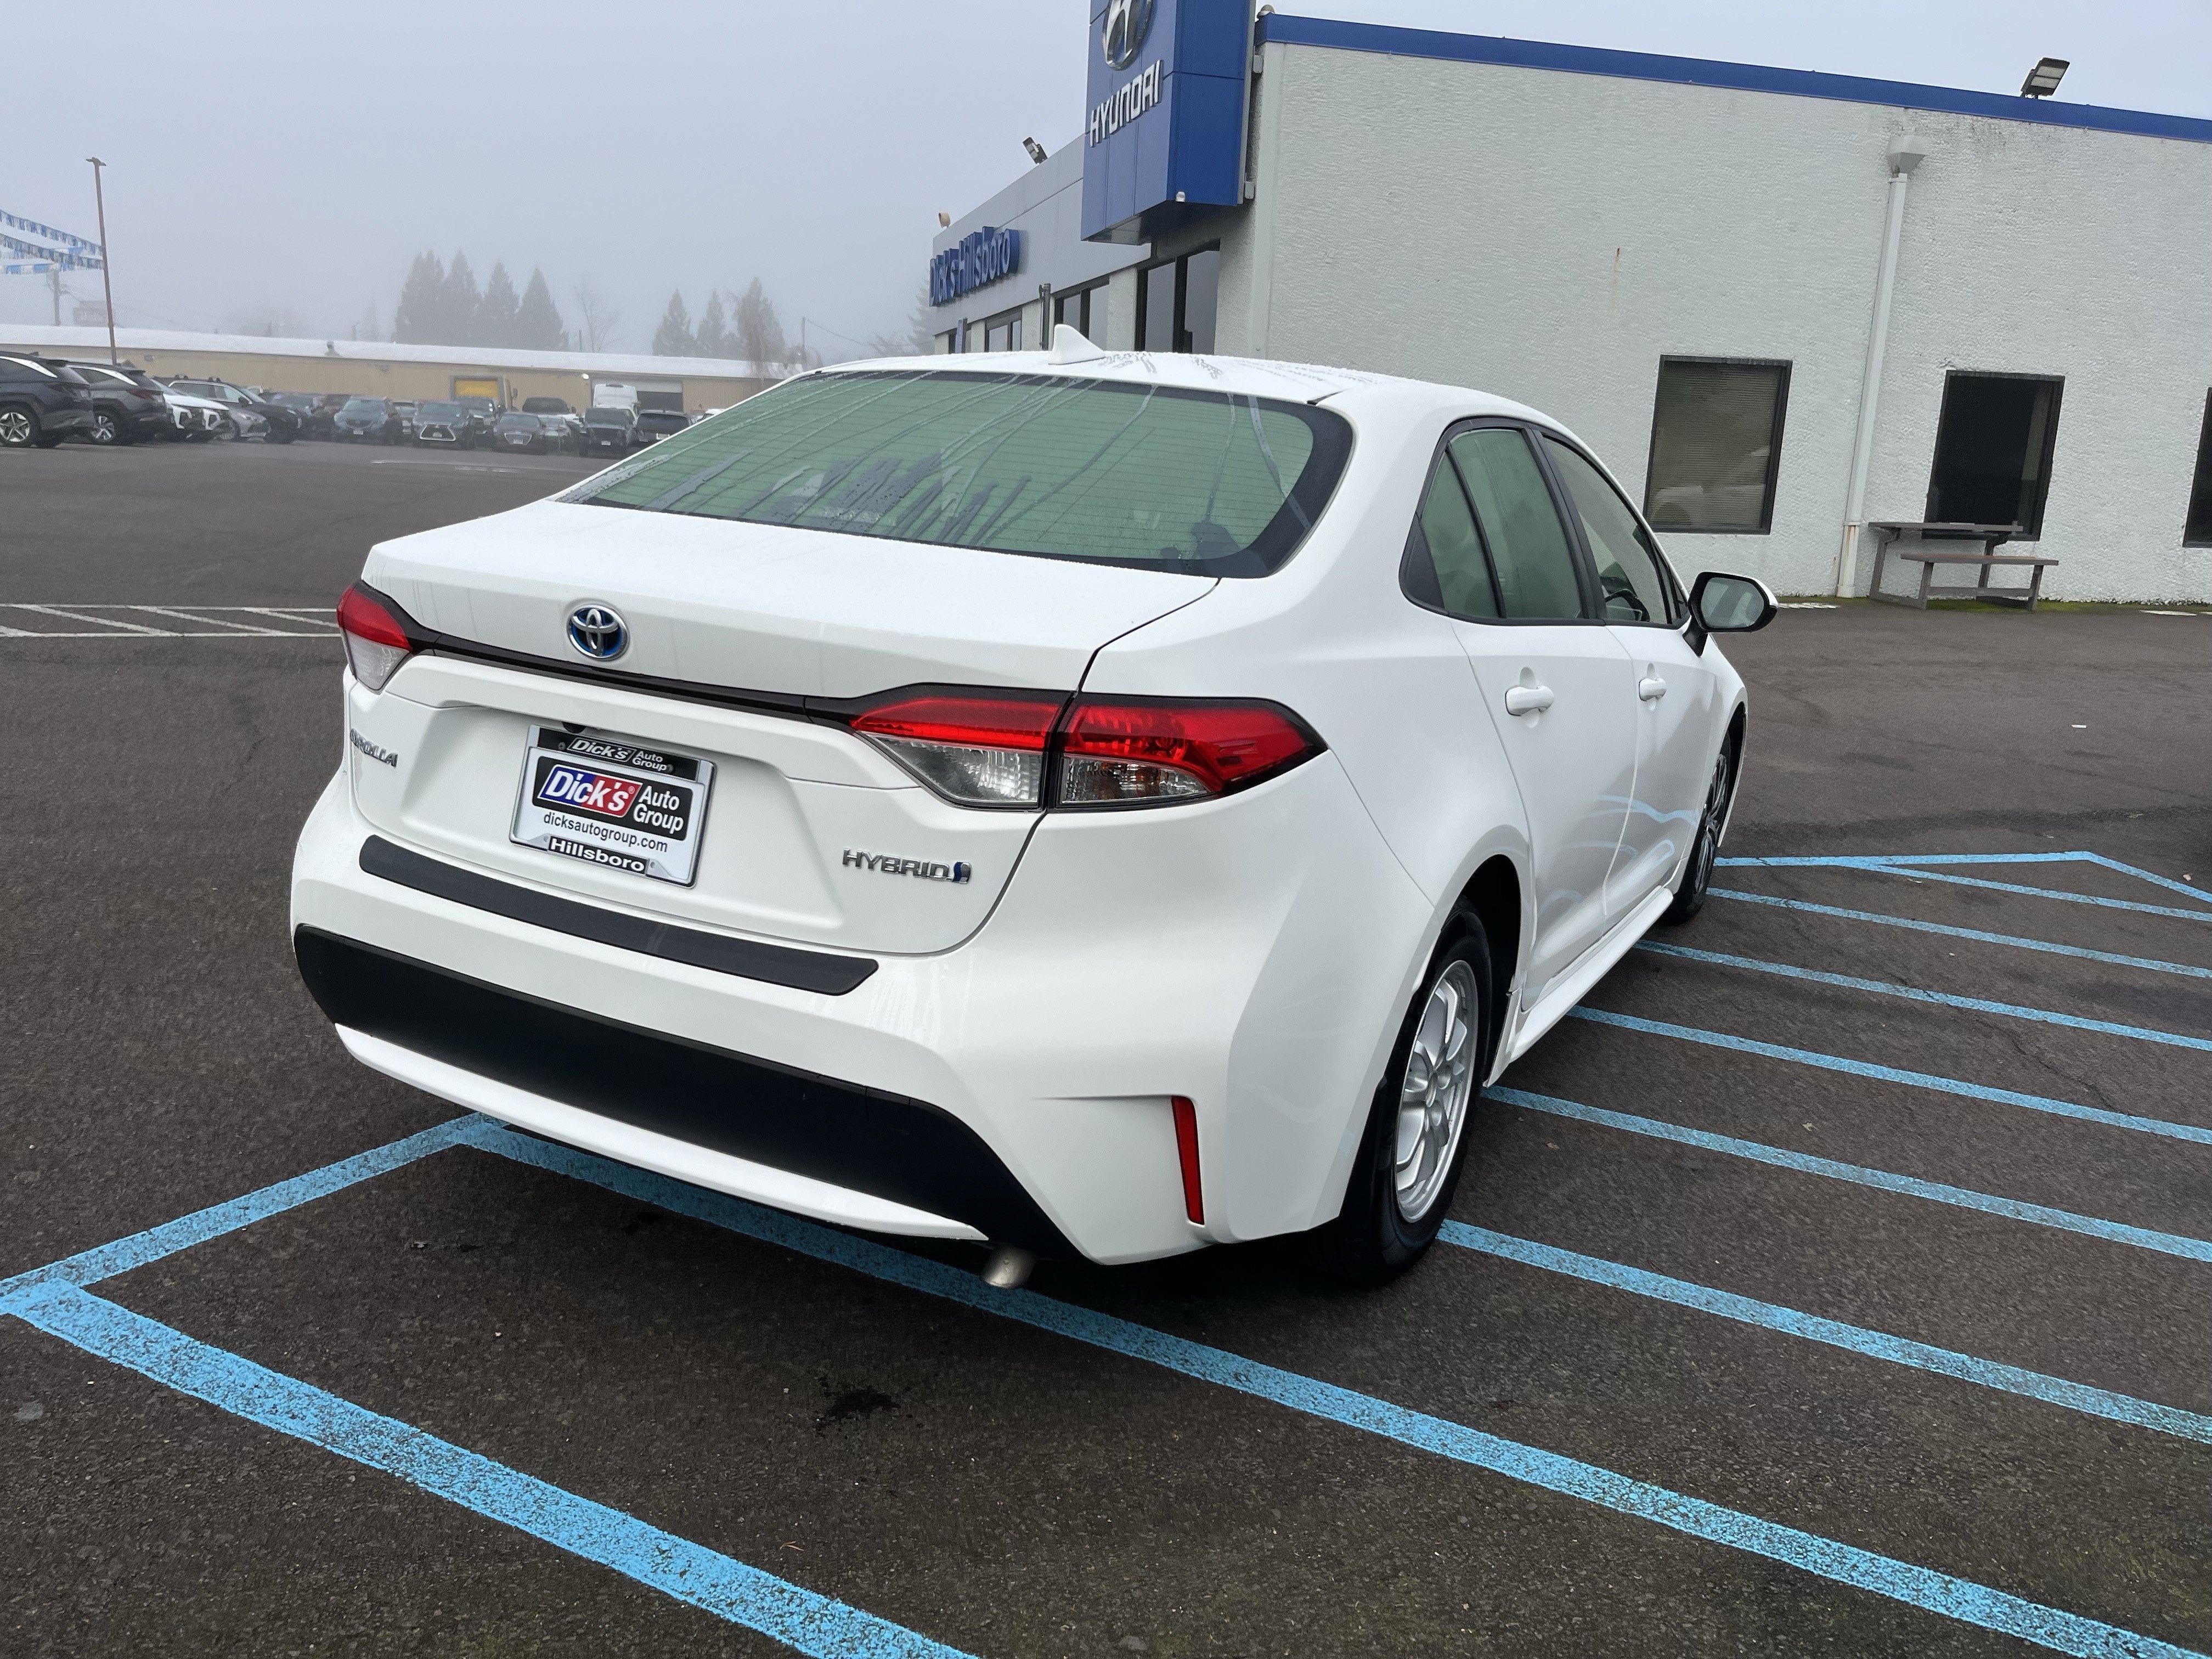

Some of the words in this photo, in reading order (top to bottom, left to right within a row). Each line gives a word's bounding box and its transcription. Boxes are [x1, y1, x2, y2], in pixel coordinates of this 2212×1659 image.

[1090, 59, 1163, 148] HYUNDAI
[572, 740, 628, 759] Dick's
[632, 758, 668, 771] Group
[636, 751, 663, 762] Auto
[545, 770, 629, 811] Dick's
[638, 786, 680, 810] Auto
[544, 812, 668, 853] dicksautogroup.com
[633, 804, 684, 834] Group
[550, 838, 645, 872] Hillsboro
[842, 848, 950, 880] HYBRID
